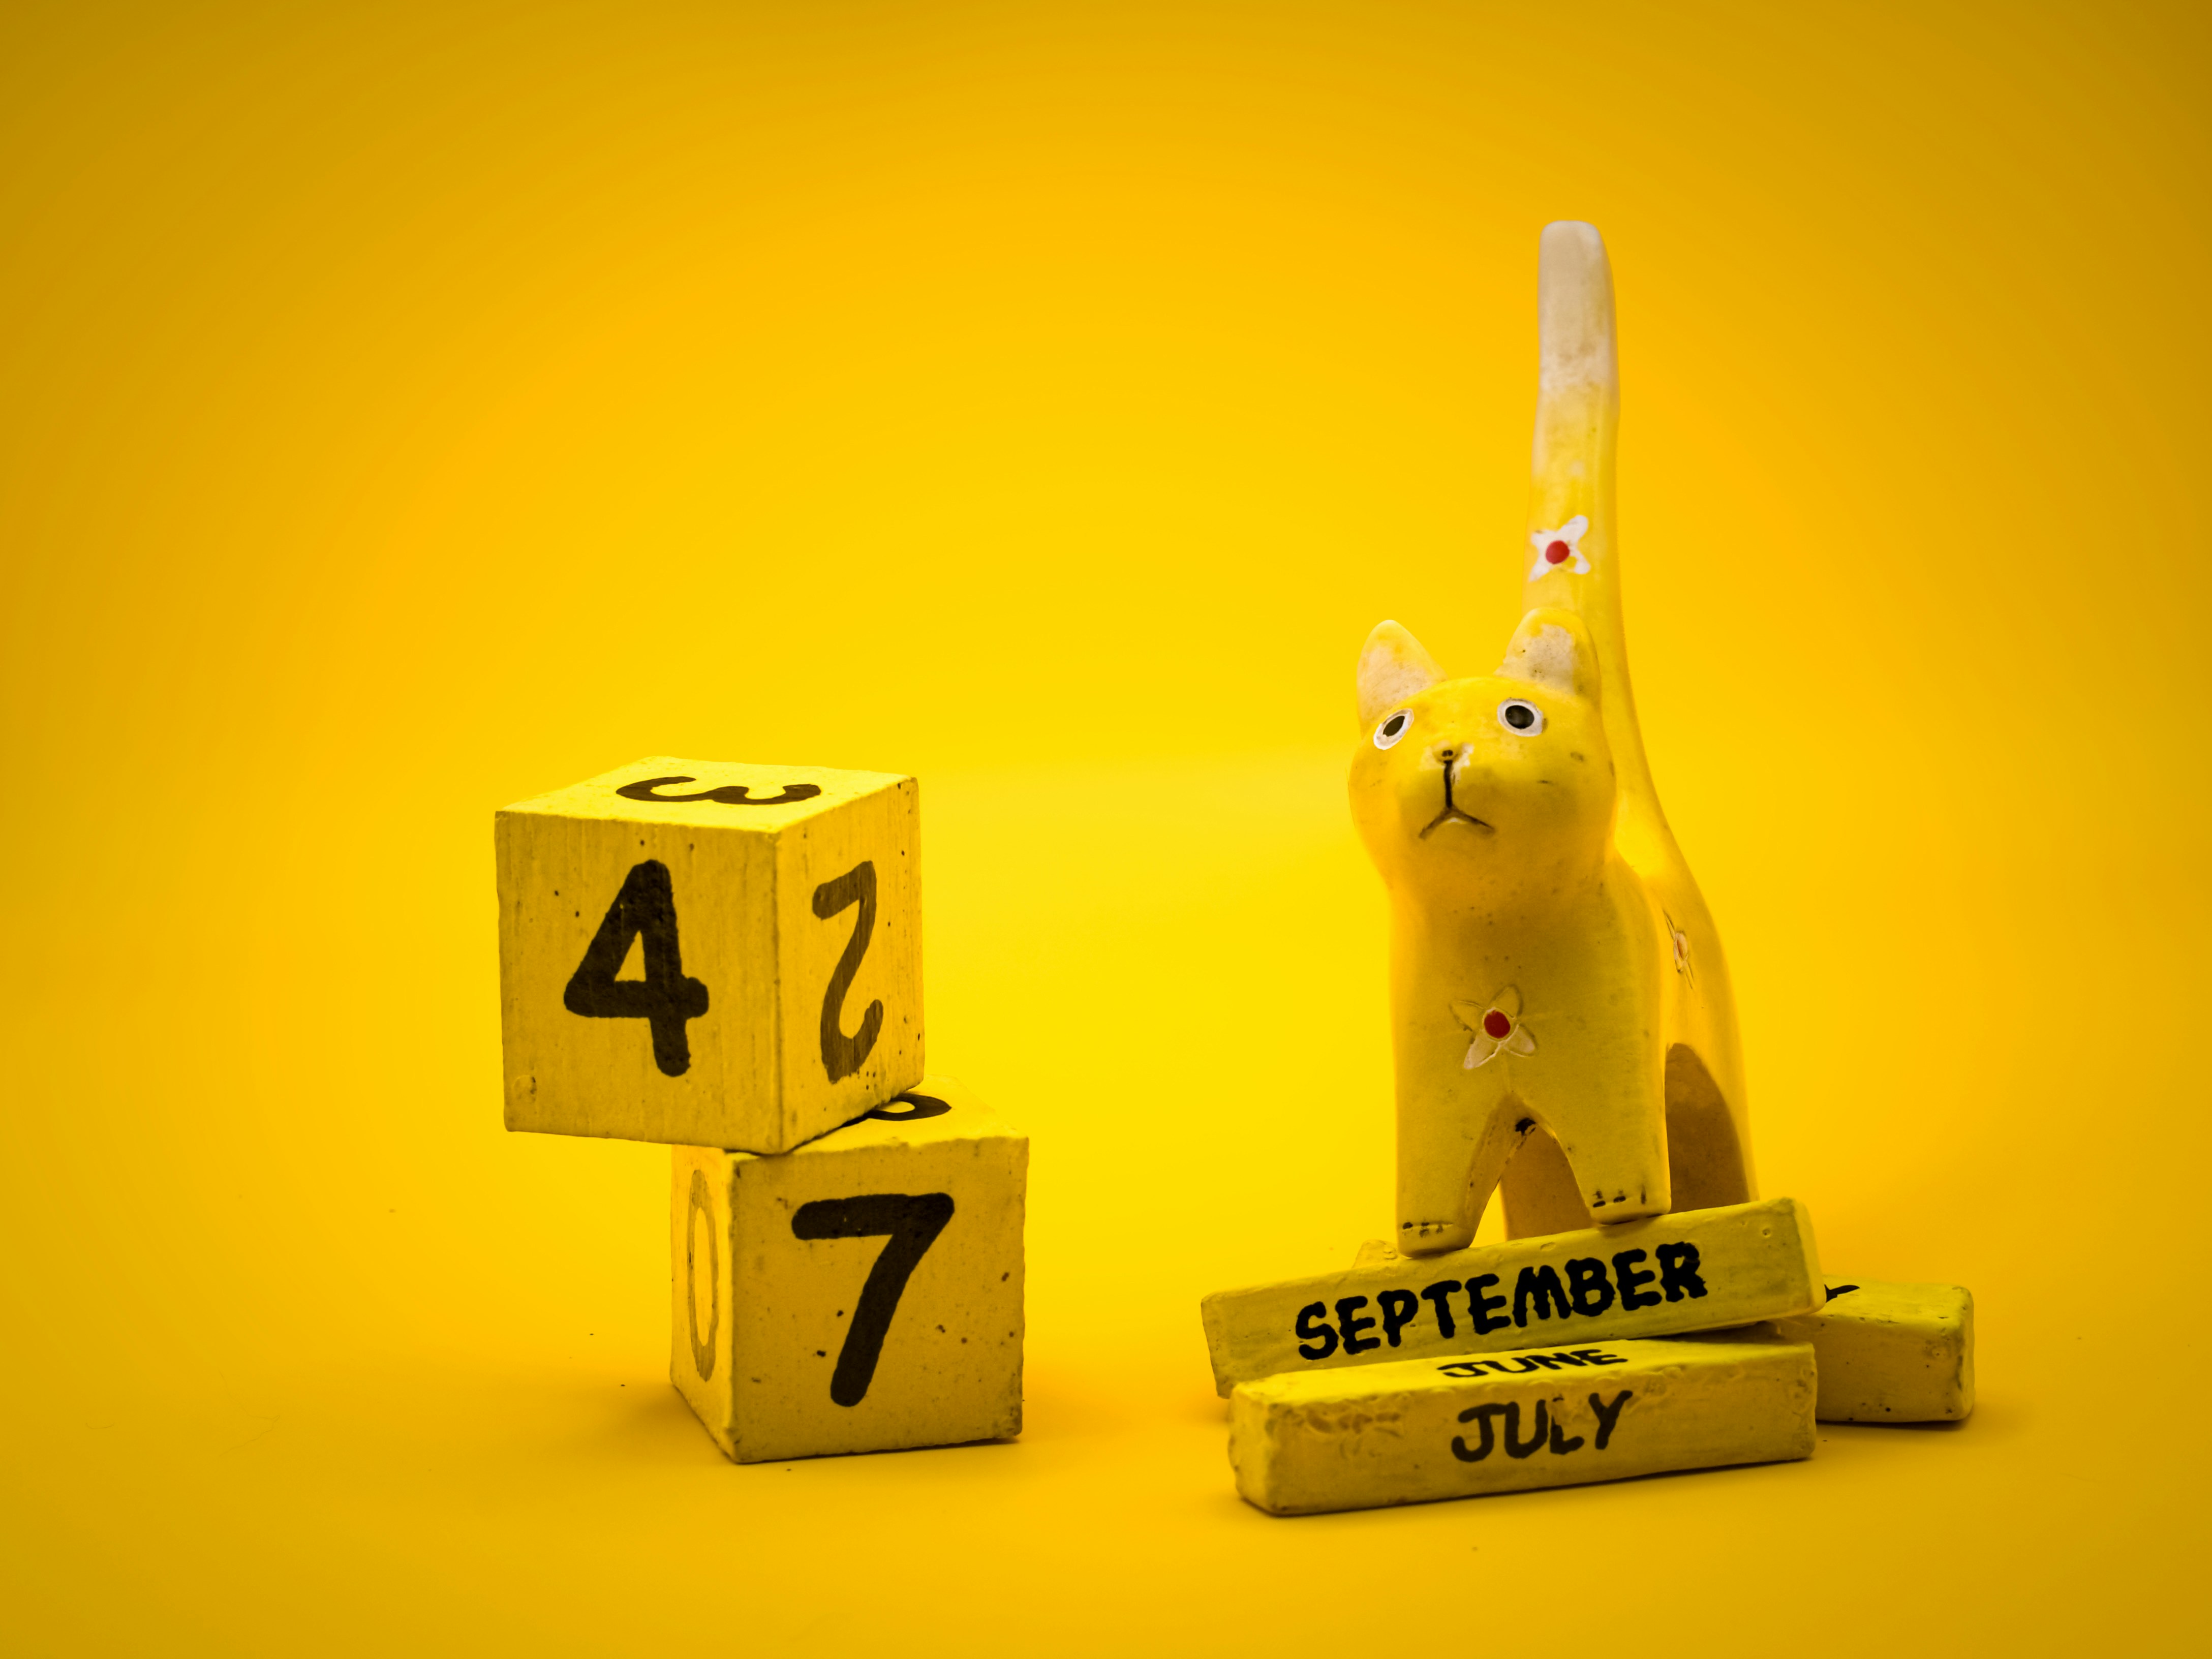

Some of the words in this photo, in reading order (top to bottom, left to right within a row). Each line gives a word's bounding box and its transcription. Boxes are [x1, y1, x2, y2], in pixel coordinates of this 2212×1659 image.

[616, 776, 821, 805] 3
[563, 859, 709, 1078] 4
[812, 860, 884, 1085] 2
[791, 1192, 955, 1408] 7
[1295, 1241, 1708, 1361] SEPTEMBER
[1436, 1349, 1629, 1378] JUNE
[1451, 1390, 1633, 1463] JULY
